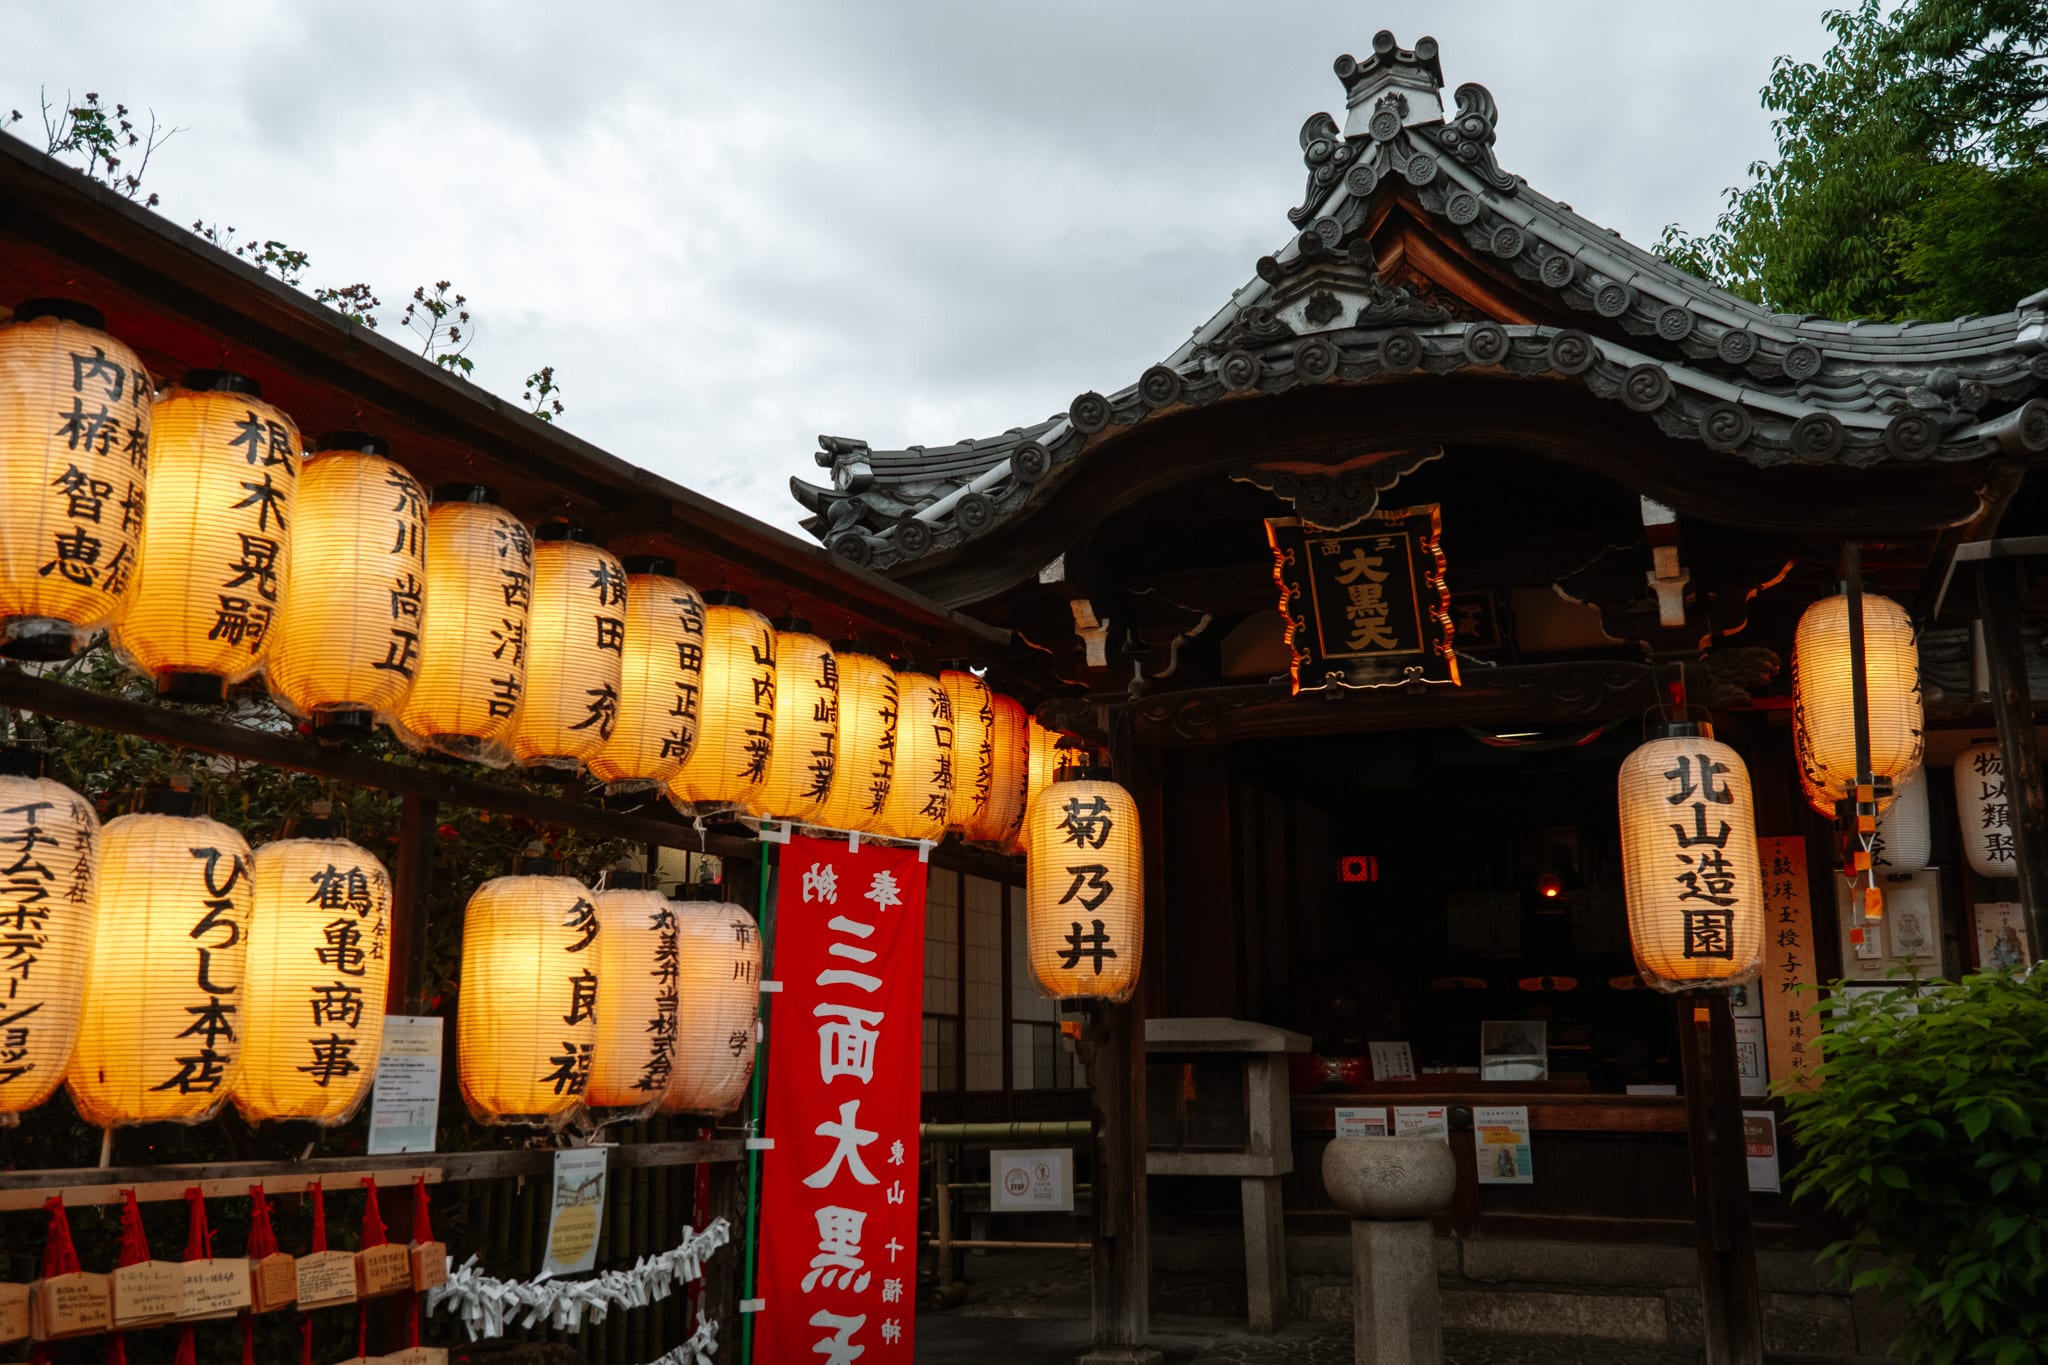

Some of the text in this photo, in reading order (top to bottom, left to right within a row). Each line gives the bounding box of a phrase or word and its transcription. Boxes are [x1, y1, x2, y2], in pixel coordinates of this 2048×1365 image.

[208, 410, 295, 654] 根木晃嗣
[372, 466, 428, 679] 荒川尚正
[1321, 537, 1396, 556] 三面
[1335, 548, 1399, 650] 大黒天
[660, 593, 704, 765] 吉田正尚
[737, 629, 776, 784] 山内工業
[864, 674, 898, 816] ミサキ工業
[1055, 795, 1117, 976] 菊乃井
[1663, 753, 1740, 960] 北山造園
[1973, 751, 2017, 863] 物以類聚
[148, 846, 249, 1094] ひろし本店
[297, 864, 374, 1088] 鶴亀商事
[728, 920, 750, 1058] 市川学
